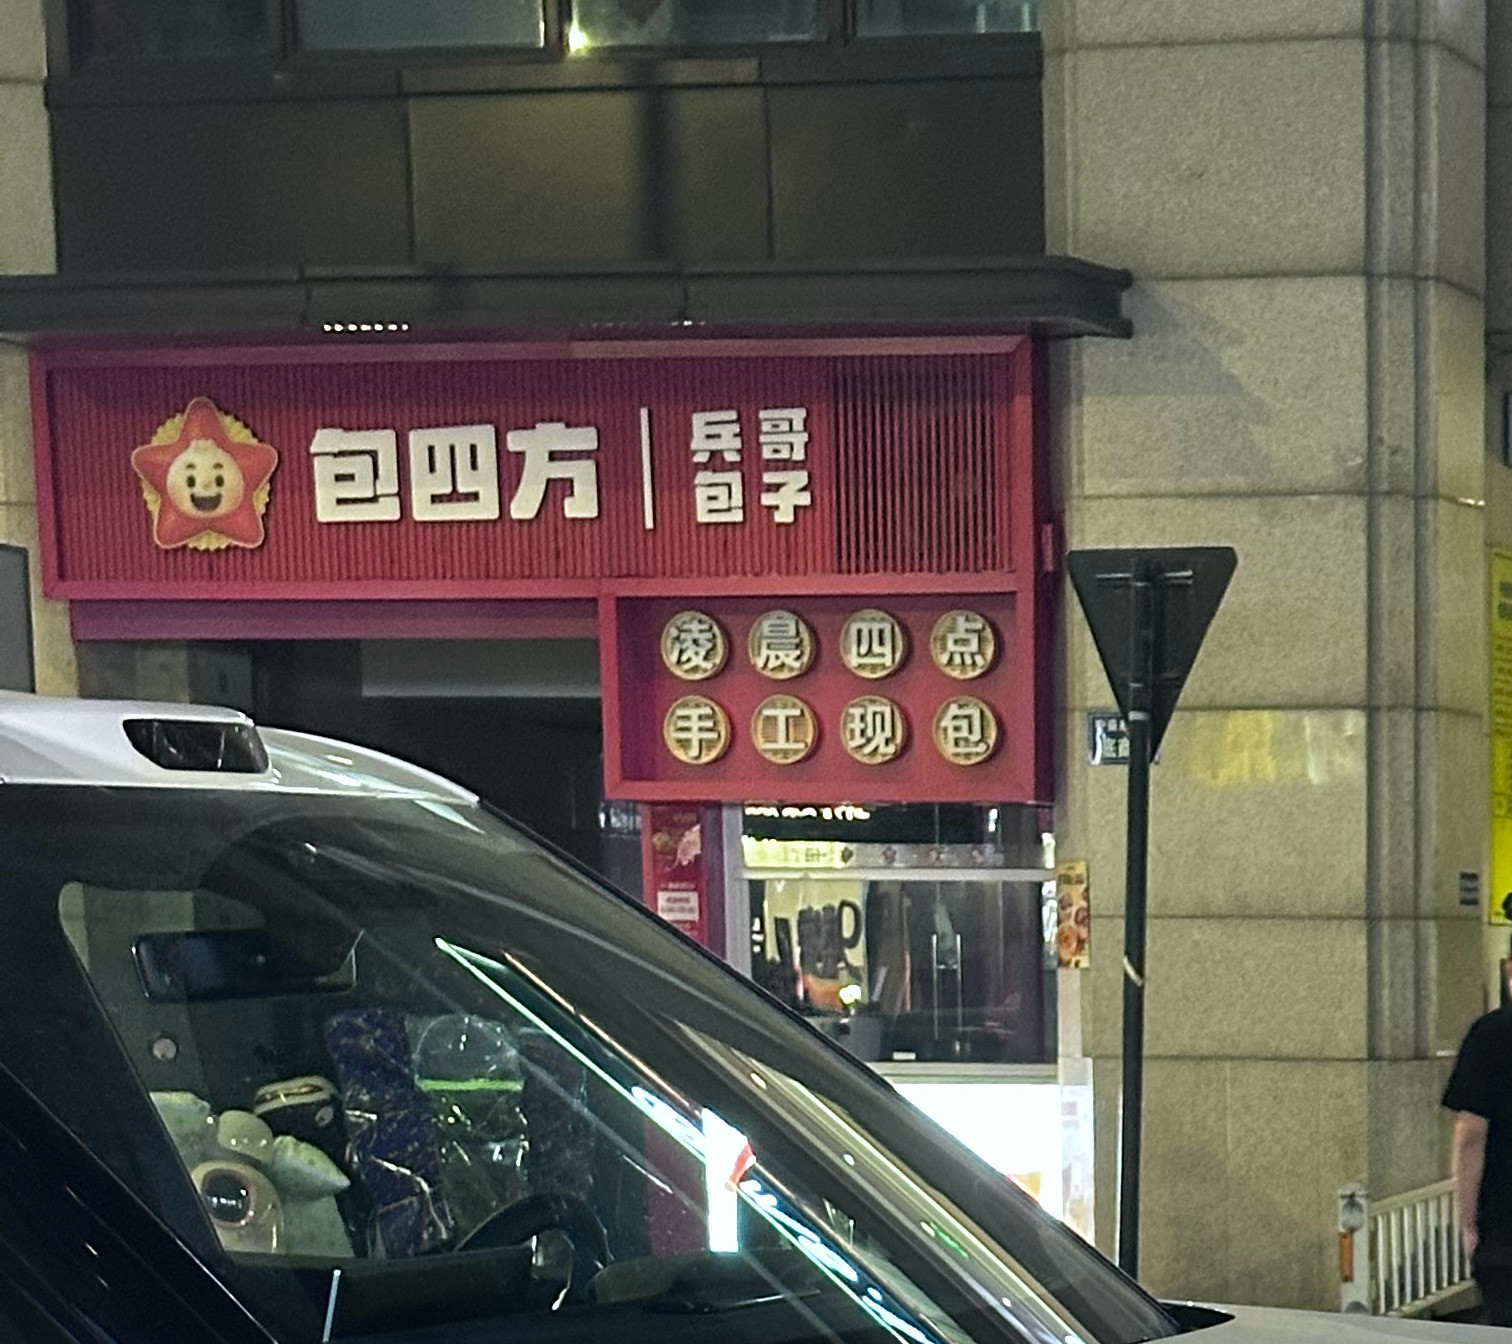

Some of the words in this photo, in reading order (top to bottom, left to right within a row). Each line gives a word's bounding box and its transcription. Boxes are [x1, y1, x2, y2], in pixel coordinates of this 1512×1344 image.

[690, 407, 809, 462] 兵哥
[310, 422, 600, 523] 包四方
[694, 470, 812, 524] 包子
[671, 614, 986, 671] 凌晨四点
[673, 700, 989, 758] 手工现包
